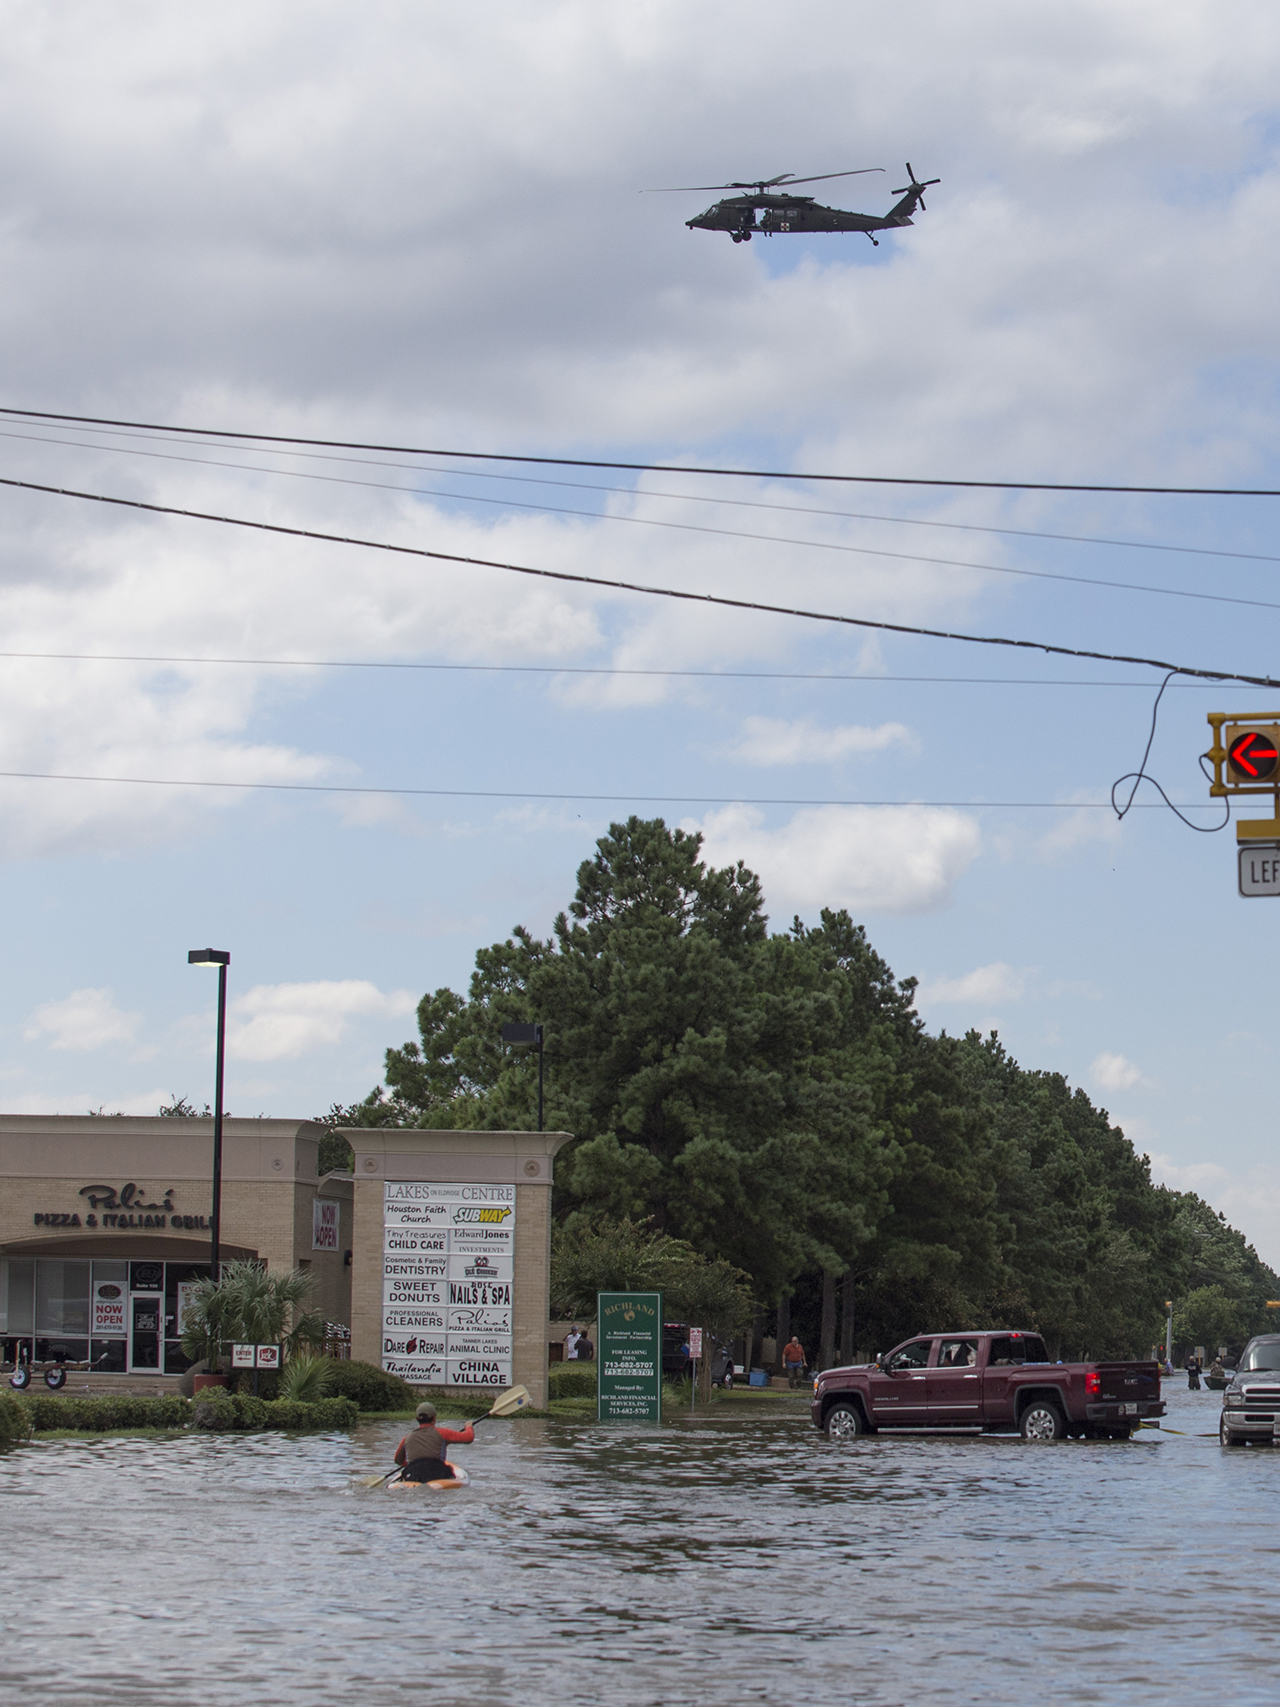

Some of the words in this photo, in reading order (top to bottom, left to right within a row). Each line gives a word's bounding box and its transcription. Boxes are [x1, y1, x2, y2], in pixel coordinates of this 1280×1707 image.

[387, 1186, 429, 1199] LAKES
[462, 1187, 513, 1200] CENTRE
[387, 1205, 421, 1213] Houston
[322, 1205, 336, 1225] NOW
[401, 1215, 431, 1223] Church
[454, 1207, 510, 1223] SUBWAY
[33, 1213, 81, 1226] PIZZA
[86, 1213, 98, 1227] &
[103, 1213, 166, 1228] ITALIAN
[320, 1226, 336, 1247] OPEN
[387, 1230, 403, 1239] Tiny
[405, 1230, 446, 1239] Treasures
[388, 1240, 417, 1249] CHILD
[420, 1241, 444, 1249] CARE
[385, 1265, 446, 1275] DENTISTRY
[393, 1282, 437, 1291] SWEET
[389, 1293, 440, 1302] DONUTS
[450, 1283, 478, 1305] NAILS
[482, 1288, 488, 1305] &
[492, 1285, 510, 1305] SPA
[96, 1305, 123, 1314] NOW
[604, 1302, 655, 1317] RICHLAND
[96, 1315, 123, 1324] OPEN
[386, 1317, 443, 1326] CLEANERS
[449, 1345, 480, 1353] ANIMAL
[483, 1346, 510, 1354] CLINIC
[386, 1362, 441, 1374] Thailandia
[459, 1362, 500, 1372] CHINA
[452, 1373, 507, 1384] VILLAGE
